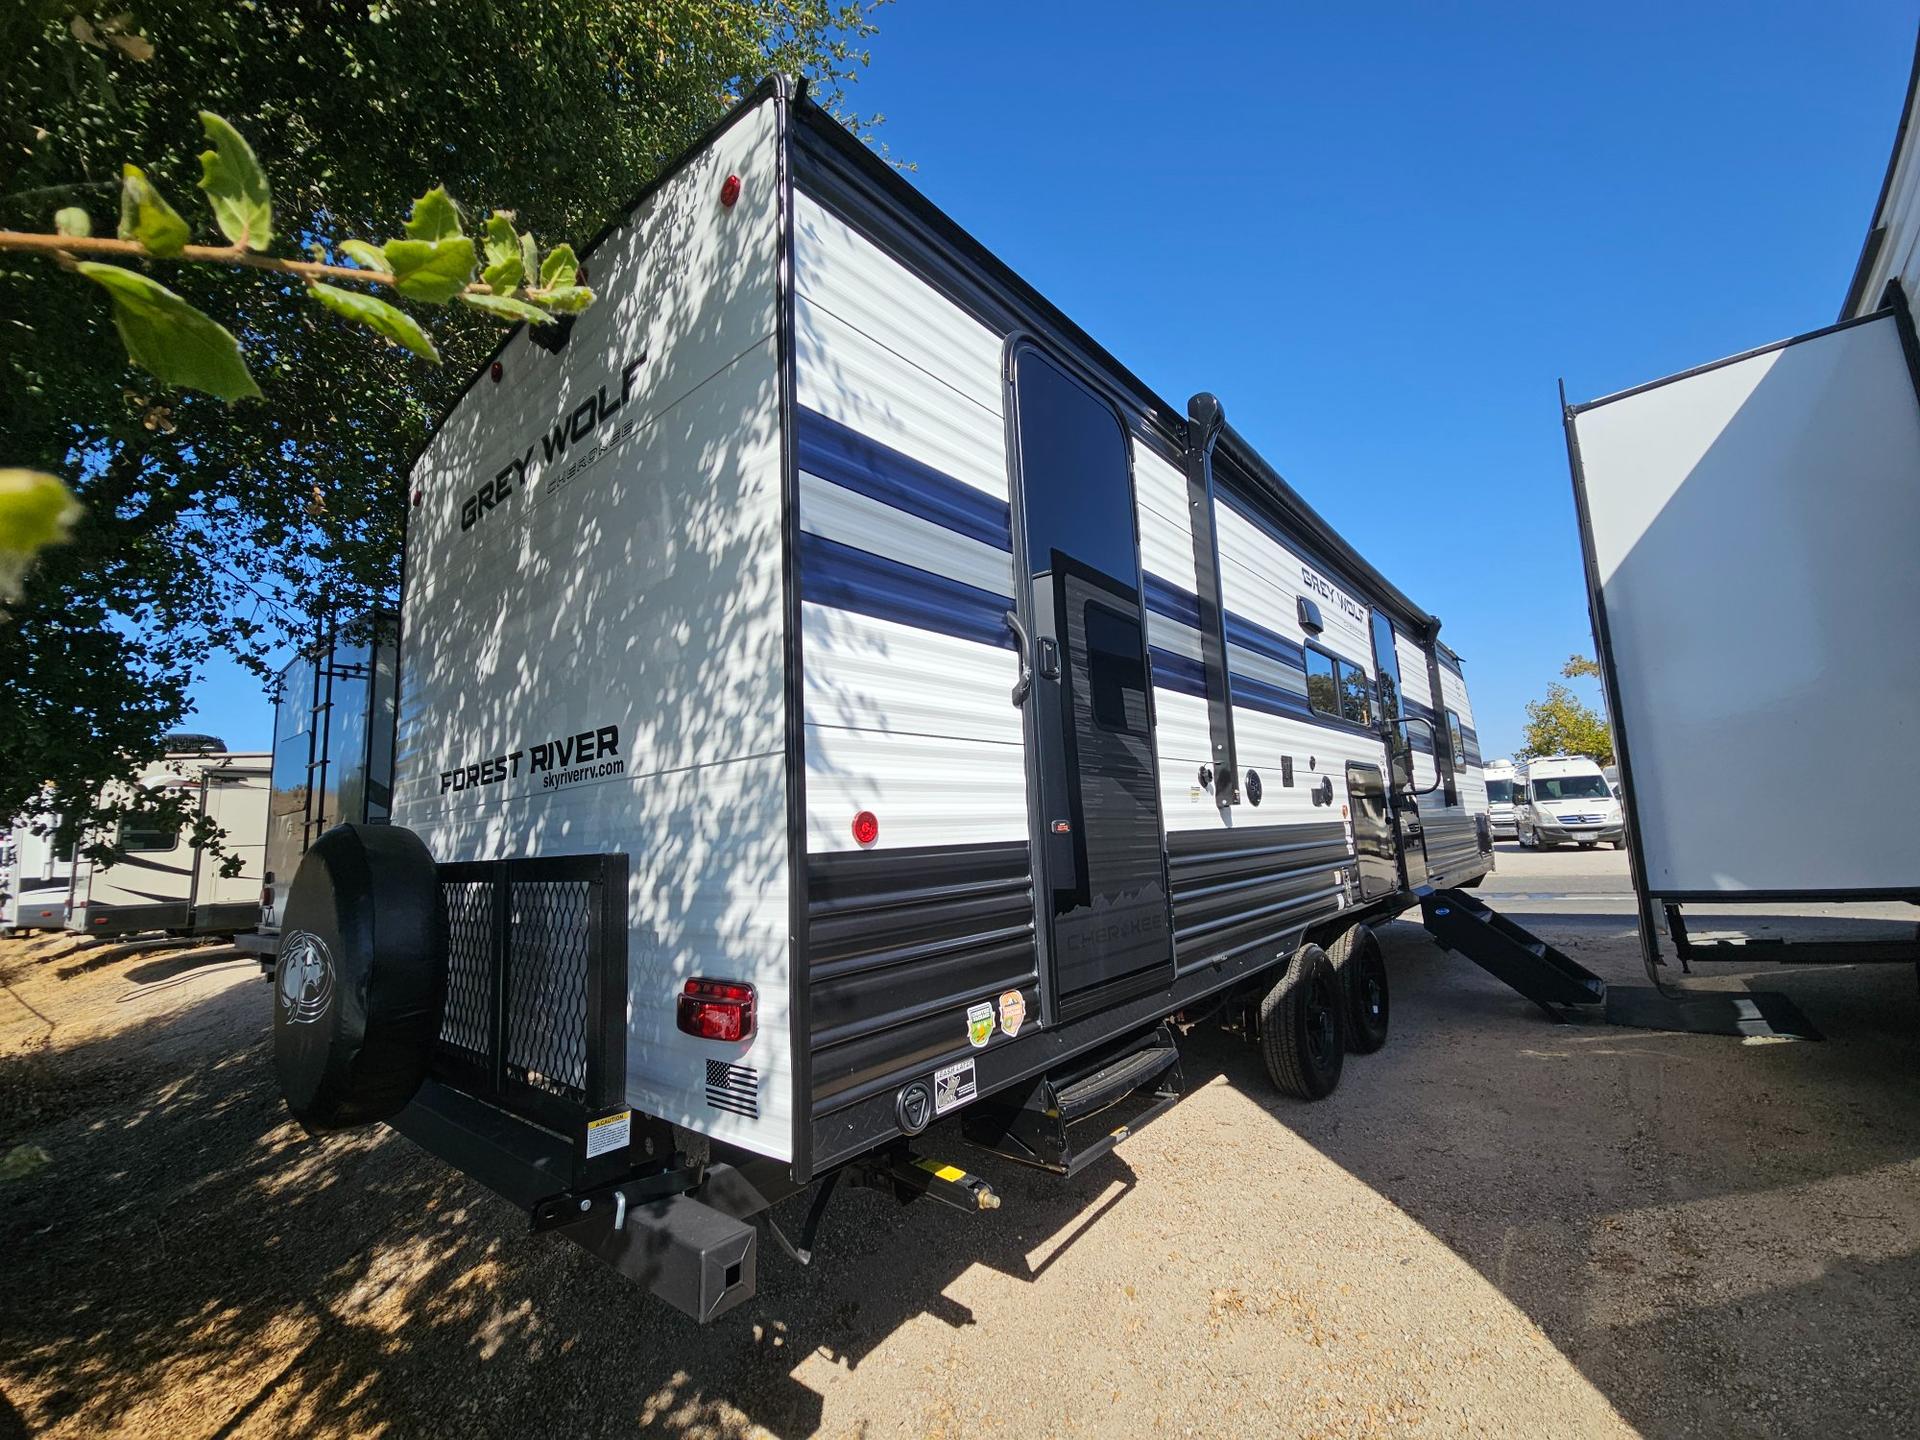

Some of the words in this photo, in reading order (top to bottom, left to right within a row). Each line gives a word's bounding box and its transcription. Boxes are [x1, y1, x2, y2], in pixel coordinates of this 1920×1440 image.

[461, 445, 534, 532] GREY
[541, 352, 647, 464] WOLF
[547, 419, 634, 494] CHEROKEE
[1302, 567, 1334, 603] GREY
[1336, 592, 1364, 623] WOLF
[440, 751, 523, 795] FOREST
[529, 725, 619, 774] RIVER
[543, 758, 624, 790] skyriverrv.com
[600, 1114, 624, 1125] CAUTION
